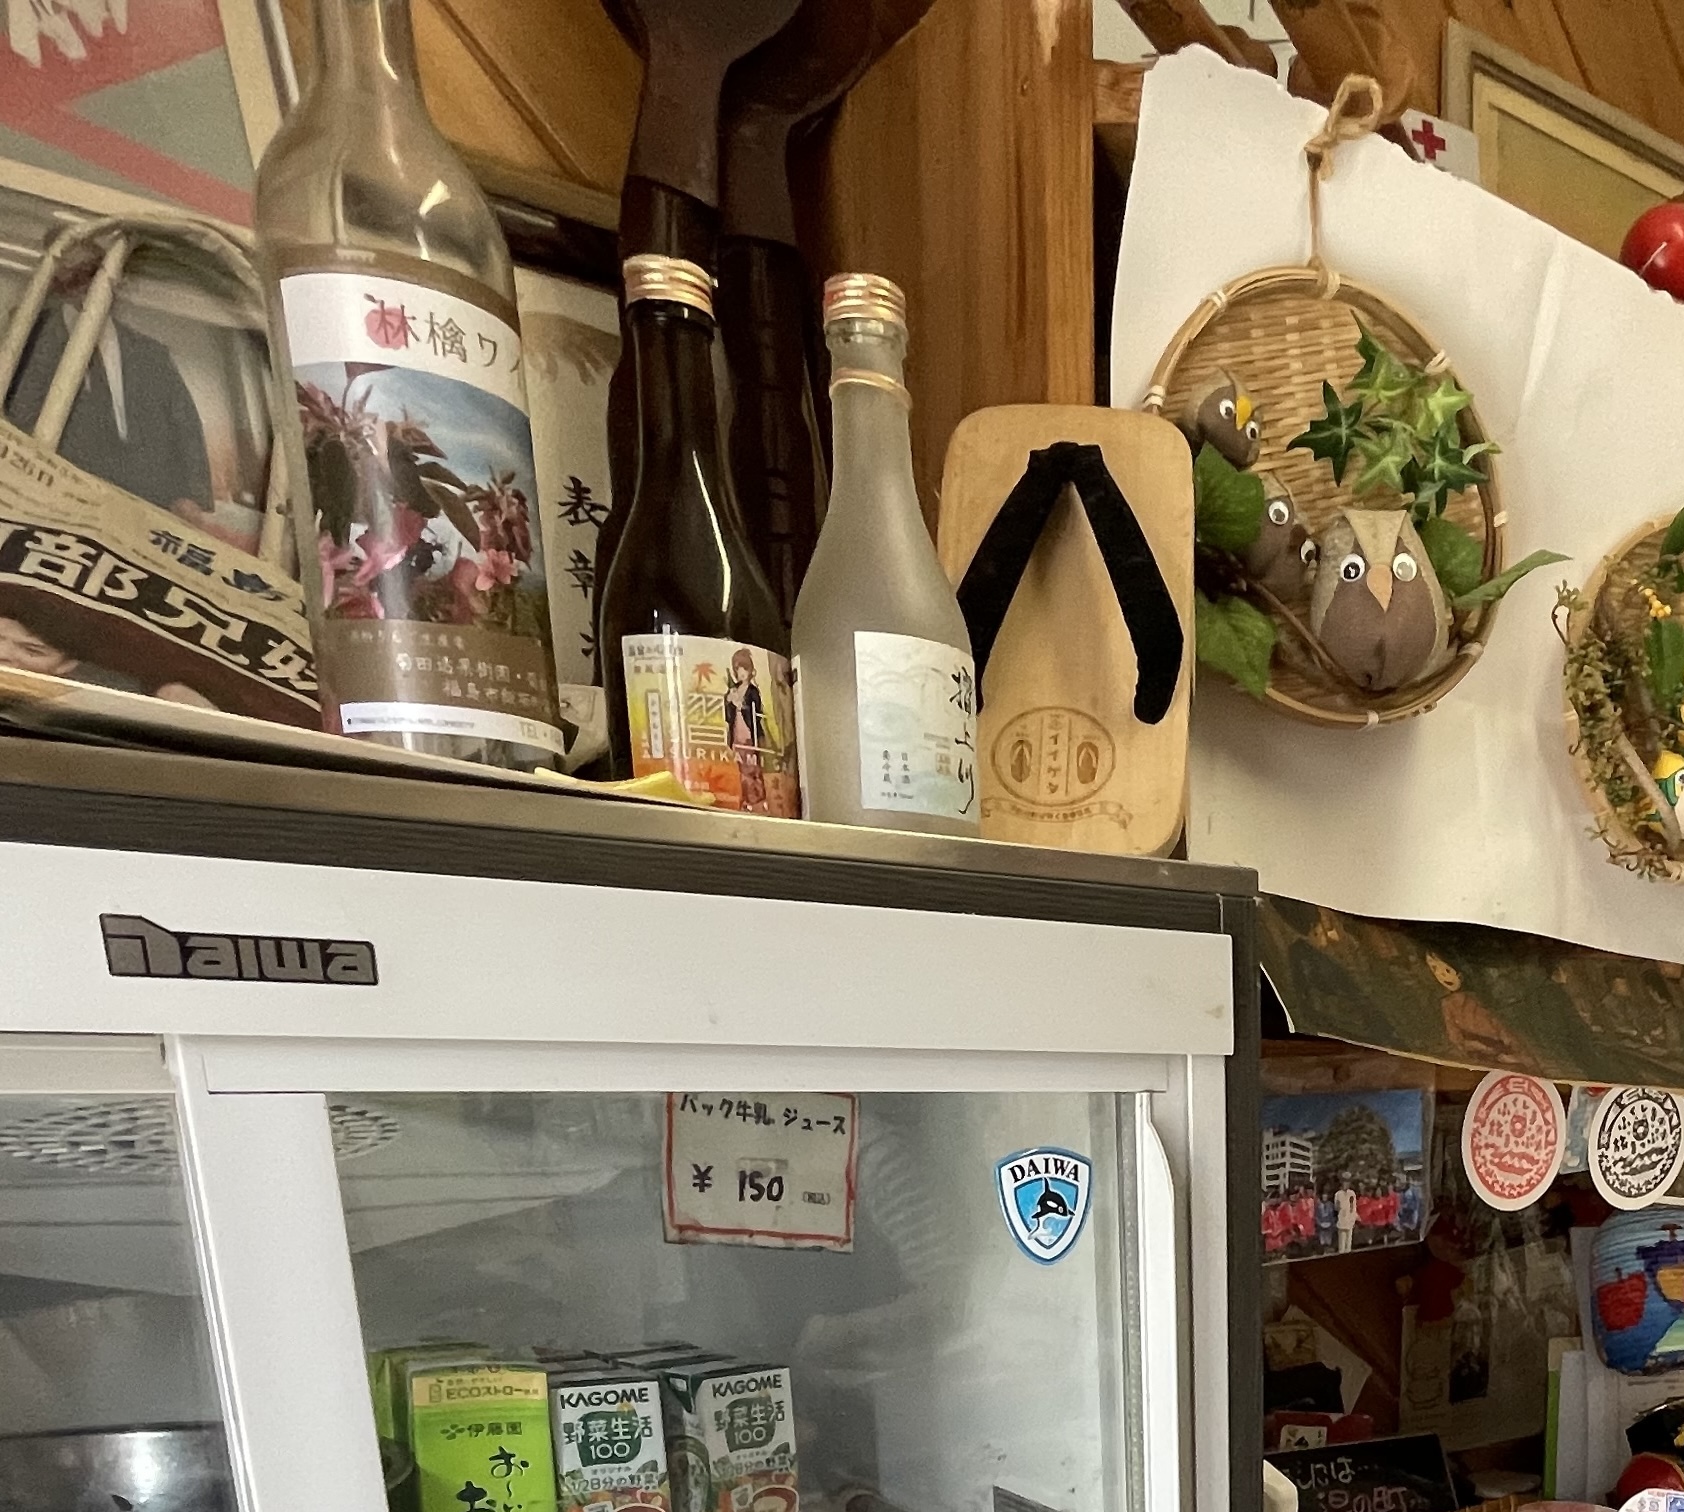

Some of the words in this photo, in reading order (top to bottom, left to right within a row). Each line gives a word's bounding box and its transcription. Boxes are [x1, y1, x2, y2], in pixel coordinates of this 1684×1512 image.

[670, 747, 765, 768] SURIKAMI
[1009, 1157, 1082, 1184] DAIWA
[738, 1169, 785, 1202] 150
[560, 1387, 649, 1409] KAGOME
[711, 1373, 783, 1399] KAGOME
[713, 1399, 786, 1432] 野菜生活
[562, 1415, 653, 1445] 野菜生活
[734, 1426, 768, 1445] 100
[589, 1442, 631, 1461] 100
